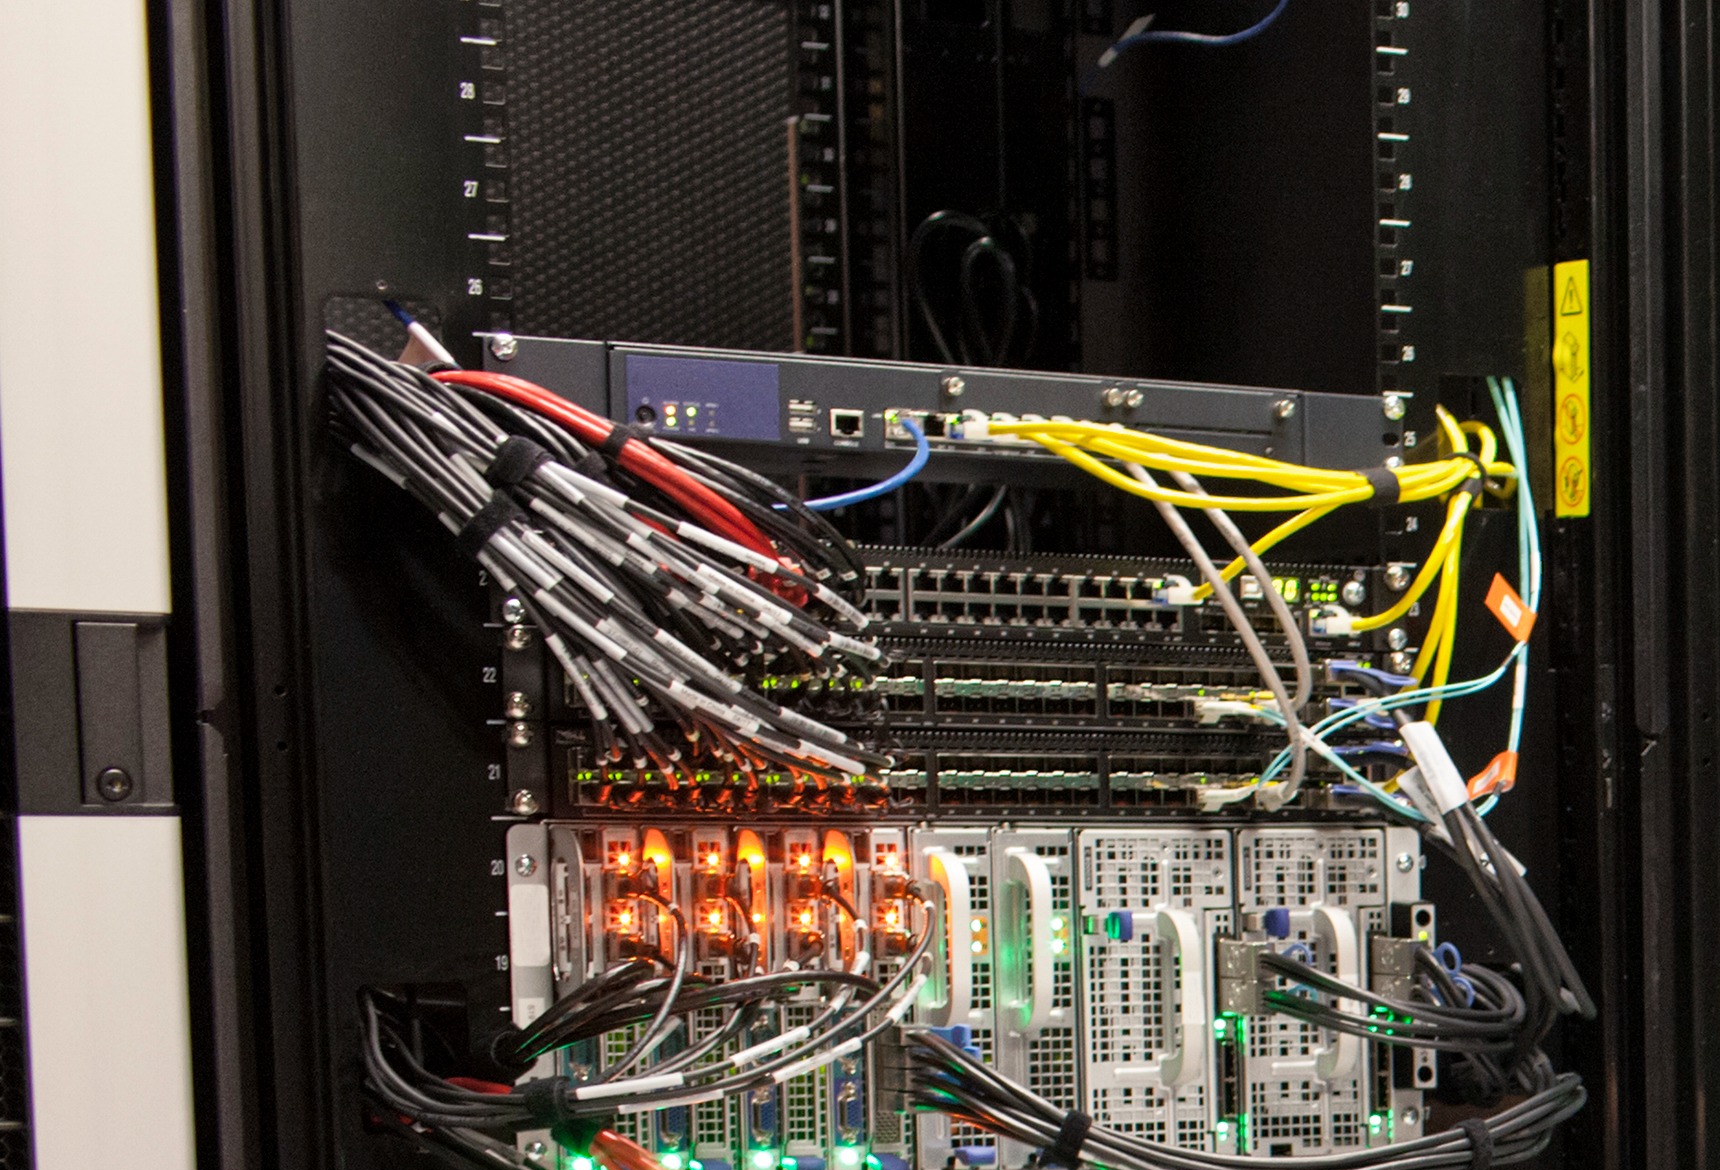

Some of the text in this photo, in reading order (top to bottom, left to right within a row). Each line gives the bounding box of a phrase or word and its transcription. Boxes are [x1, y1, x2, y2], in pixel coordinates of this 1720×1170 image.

[460, 82, 475, 99] 28
[464, 181, 478, 197] 27
[1399, 174, 1411, 189] 28
[1401, 260, 1413, 275] 27
[468, 279, 482, 295] 26
[1403, 346, 1414, 361] 26
[1404, 431, 1416, 446] 25
[1406, 517, 1417, 531] 24
[479, 571, 487, 586] 2
[483, 667, 496, 683] 22
[488, 764, 500, 779] 21
[491, 860, 505, 876] 20
[495, 955, 509, 971] 19
